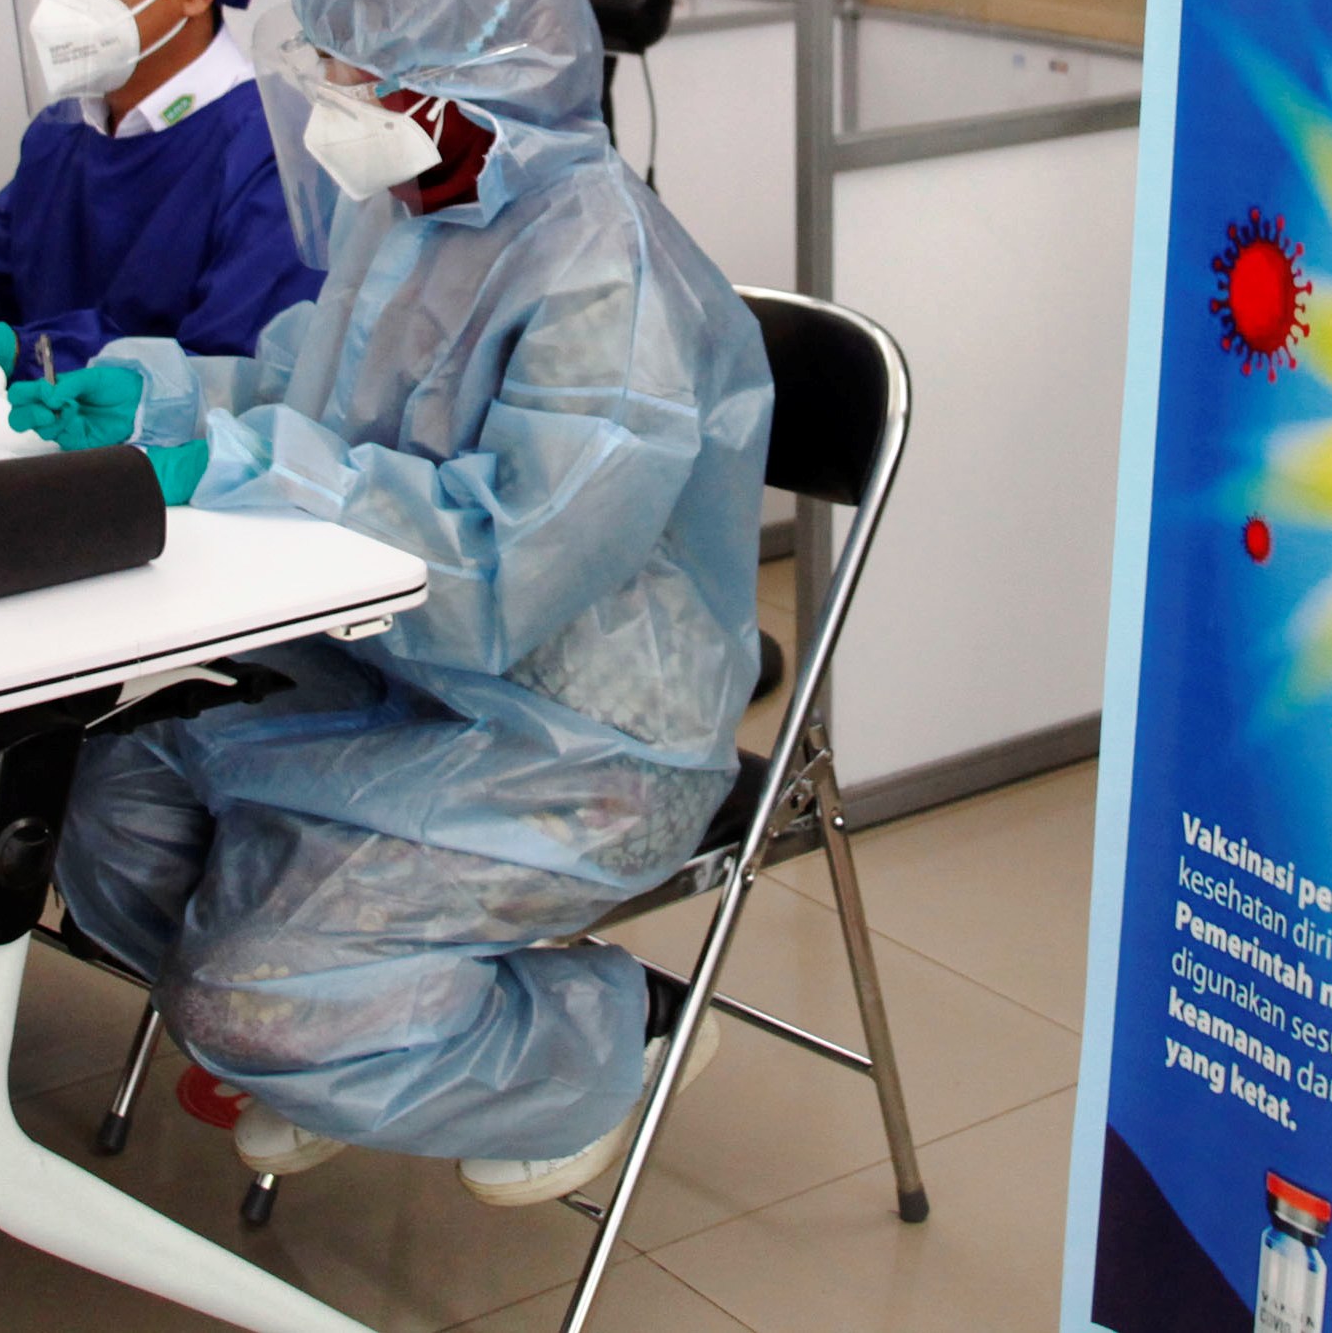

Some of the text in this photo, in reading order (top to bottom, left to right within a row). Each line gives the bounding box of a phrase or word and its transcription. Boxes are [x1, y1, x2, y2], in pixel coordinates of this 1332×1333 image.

[1181, 813, 1294, 894] Vaksinasi
[1175, 902, 1312, 1000] Pemerintah
[1179, 858, 1287, 938] kesehatan
[1293, 916, 1332, 960] diri
[1167, 986, 1291, 1082] keamanan
[1172, 948, 1285, 1031] digunakan
[1166, 1039, 1297, 1132] yang ketat.
